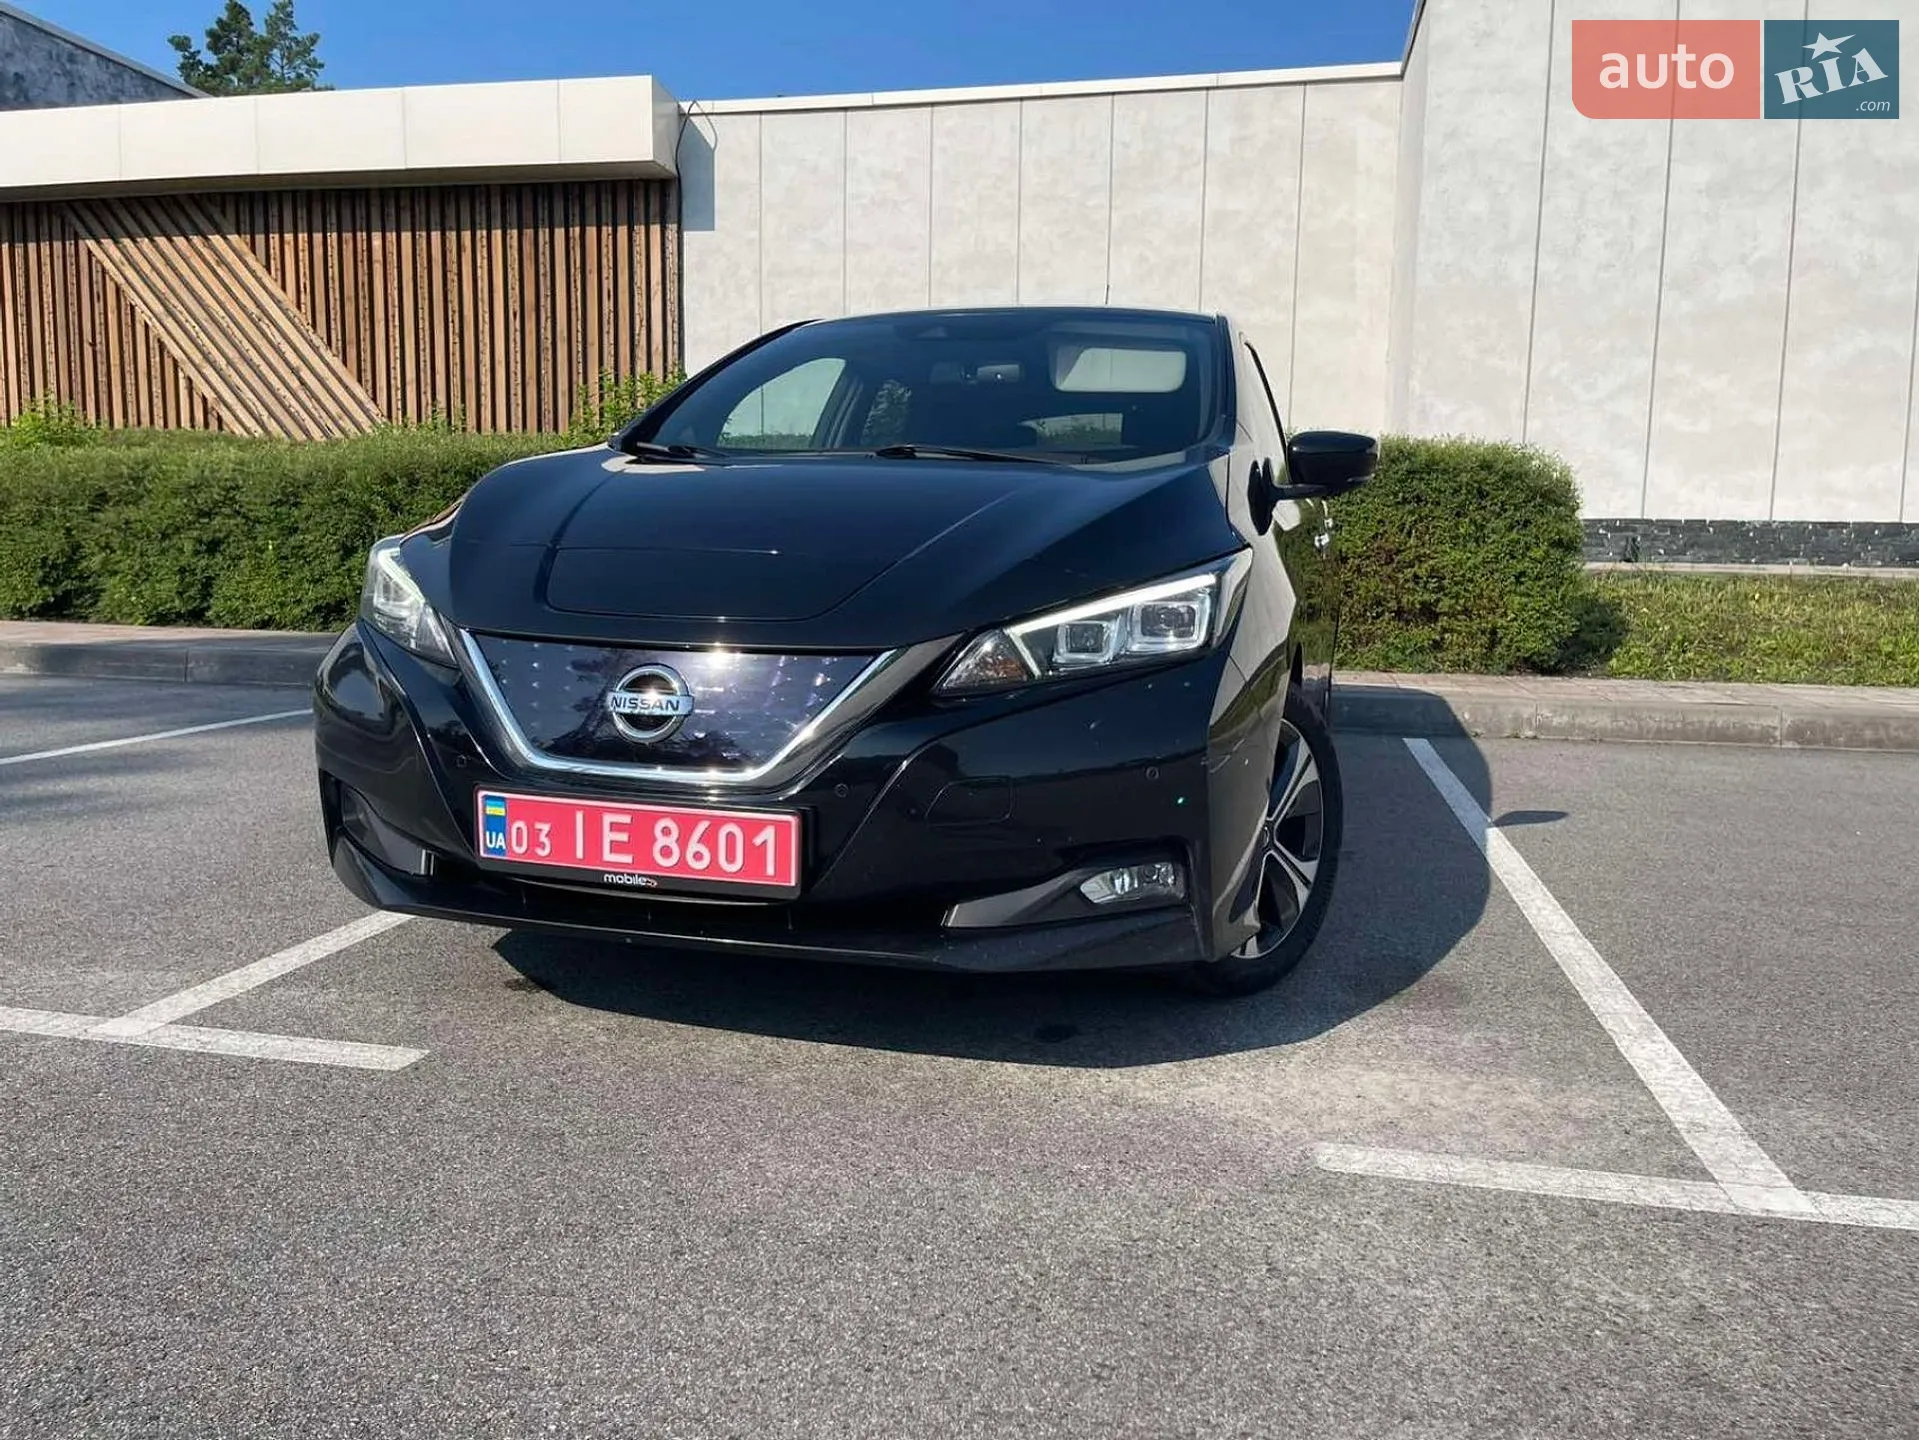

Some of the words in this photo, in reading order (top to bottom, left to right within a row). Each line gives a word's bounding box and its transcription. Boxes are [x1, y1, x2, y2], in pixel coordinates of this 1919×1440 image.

[610, 695, 680, 711] NISSAN
[486, 830, 506, 850] UA
[510, 820, 552, 857] 03
[575, 810, 634, 864] IE
[652, 817, 776, 876] 8601
